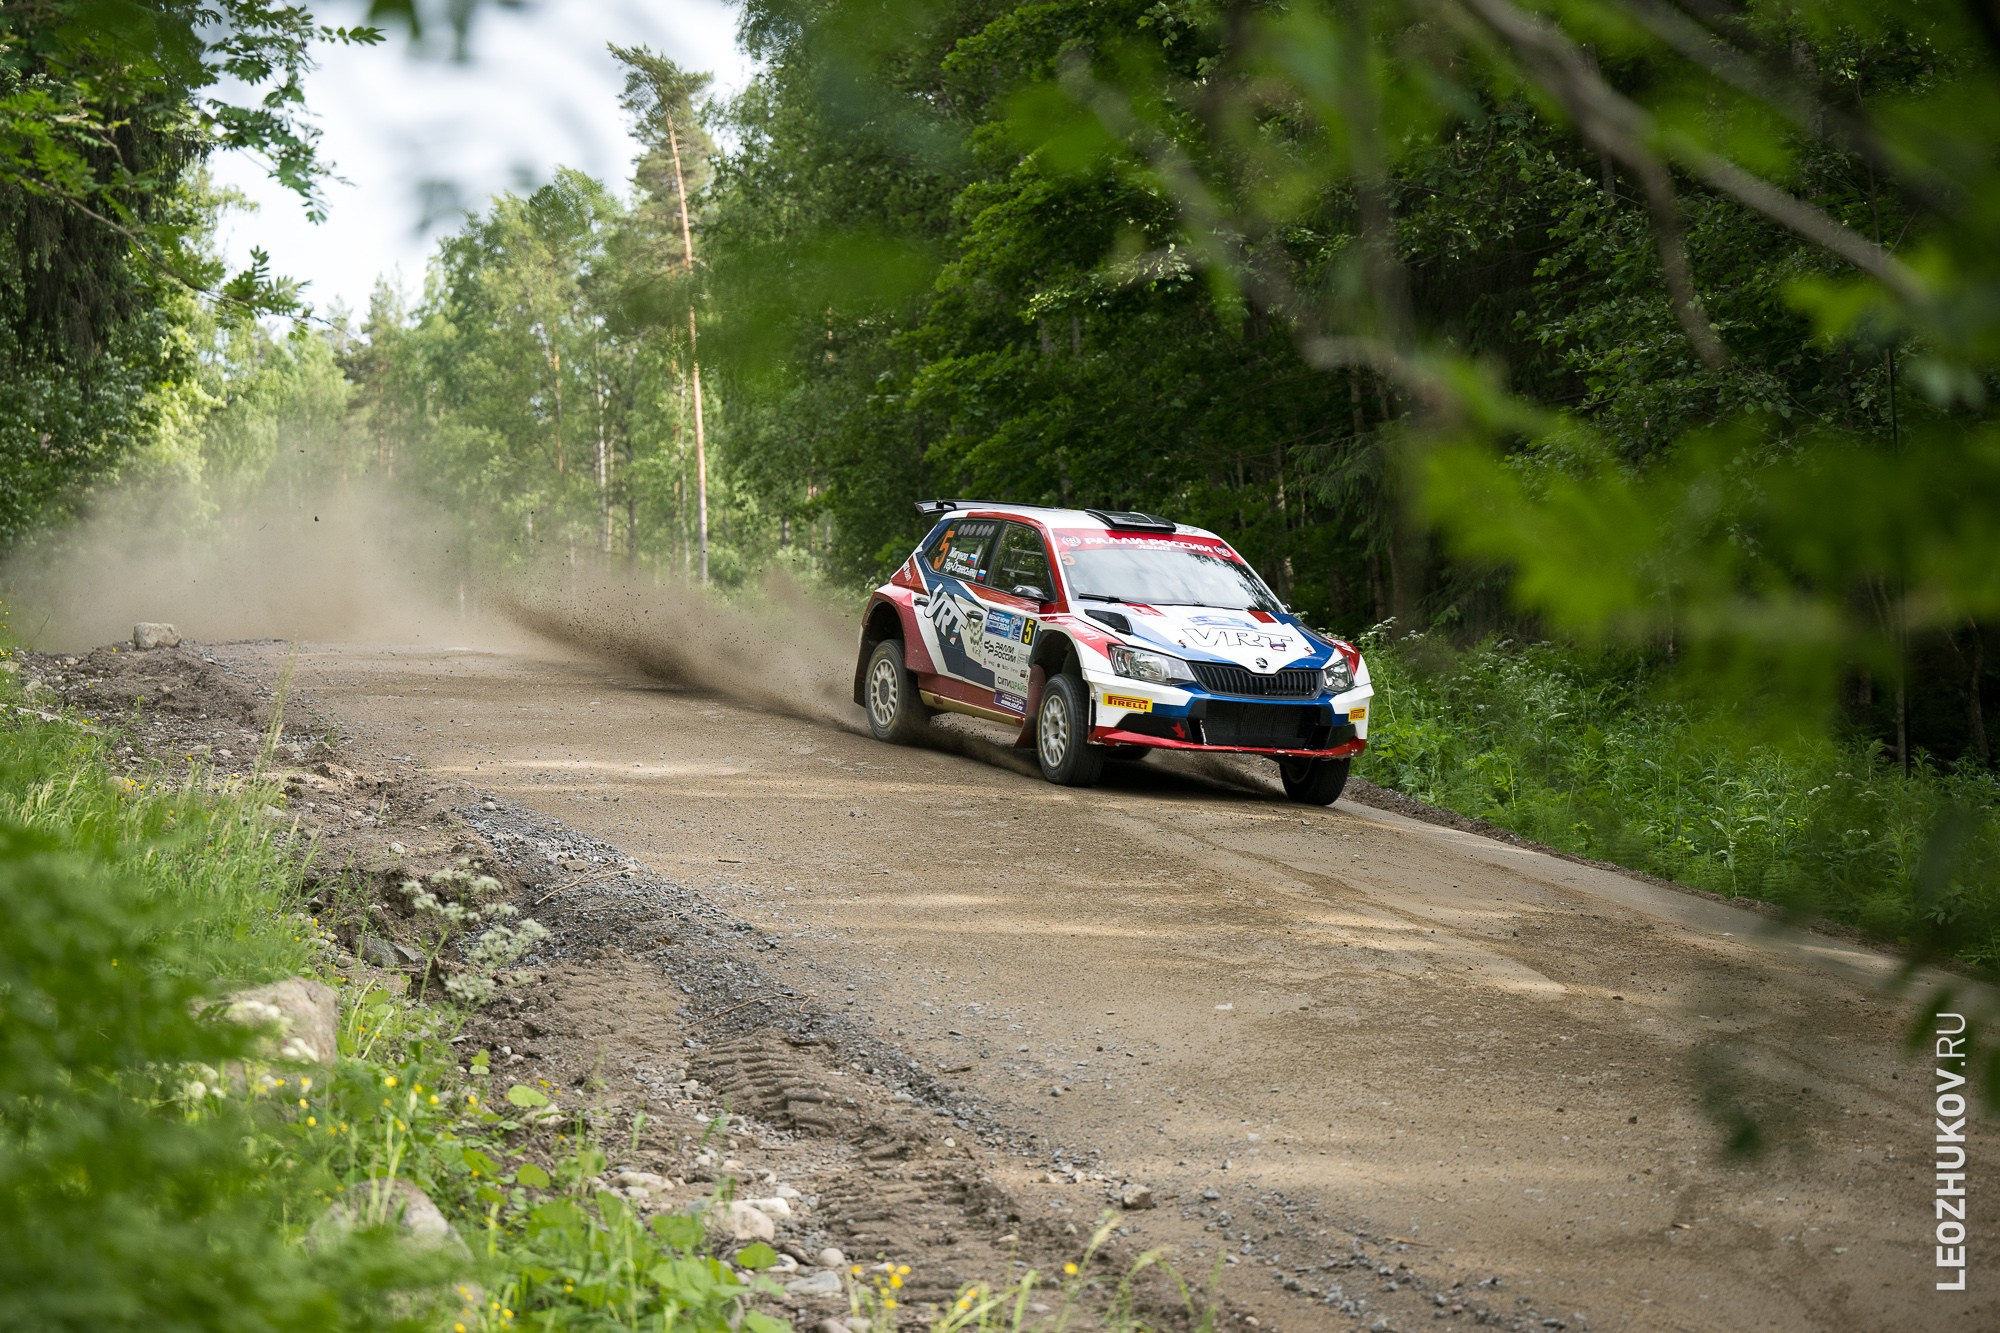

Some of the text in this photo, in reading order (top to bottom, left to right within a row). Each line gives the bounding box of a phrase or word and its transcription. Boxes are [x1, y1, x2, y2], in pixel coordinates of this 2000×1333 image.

[933, 531, 955, 569] 5
[1084, 537, 1213, 553] РАЛЛИ РОССИИ
[1060, 551, 1076, 566] 5
[924, 582, 970, 647] VRT
[1024, 619, 1034, 644] 5
[1182, 627, 1293, 651] VRT
[995, 642, 1015, 654] РАЛЛИ
[993, 650, 1017, 663] РОССИИ
[1107, 695, 1149, 710] PIRELLI
